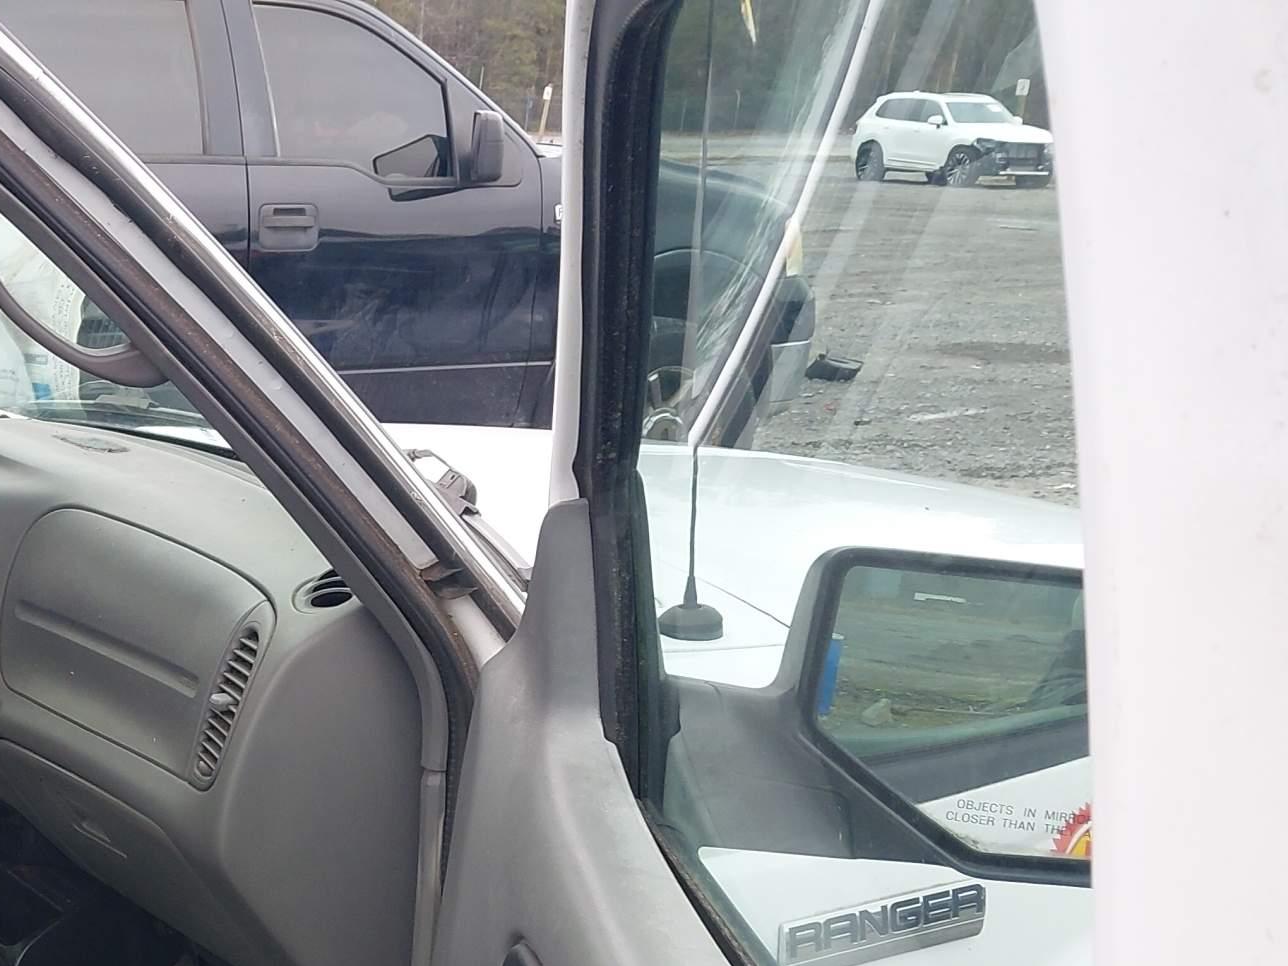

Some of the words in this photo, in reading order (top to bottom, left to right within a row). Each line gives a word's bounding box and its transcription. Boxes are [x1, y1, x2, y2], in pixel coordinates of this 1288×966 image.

[956, 798, 1014, 816] OBJECTS
[1023, 807, 1037, 818] IN
[945, 810, 996, 826] CLOSER
[1002, 818, 1036, 831] THAN
[789, 883, 986, 959] RANGER
